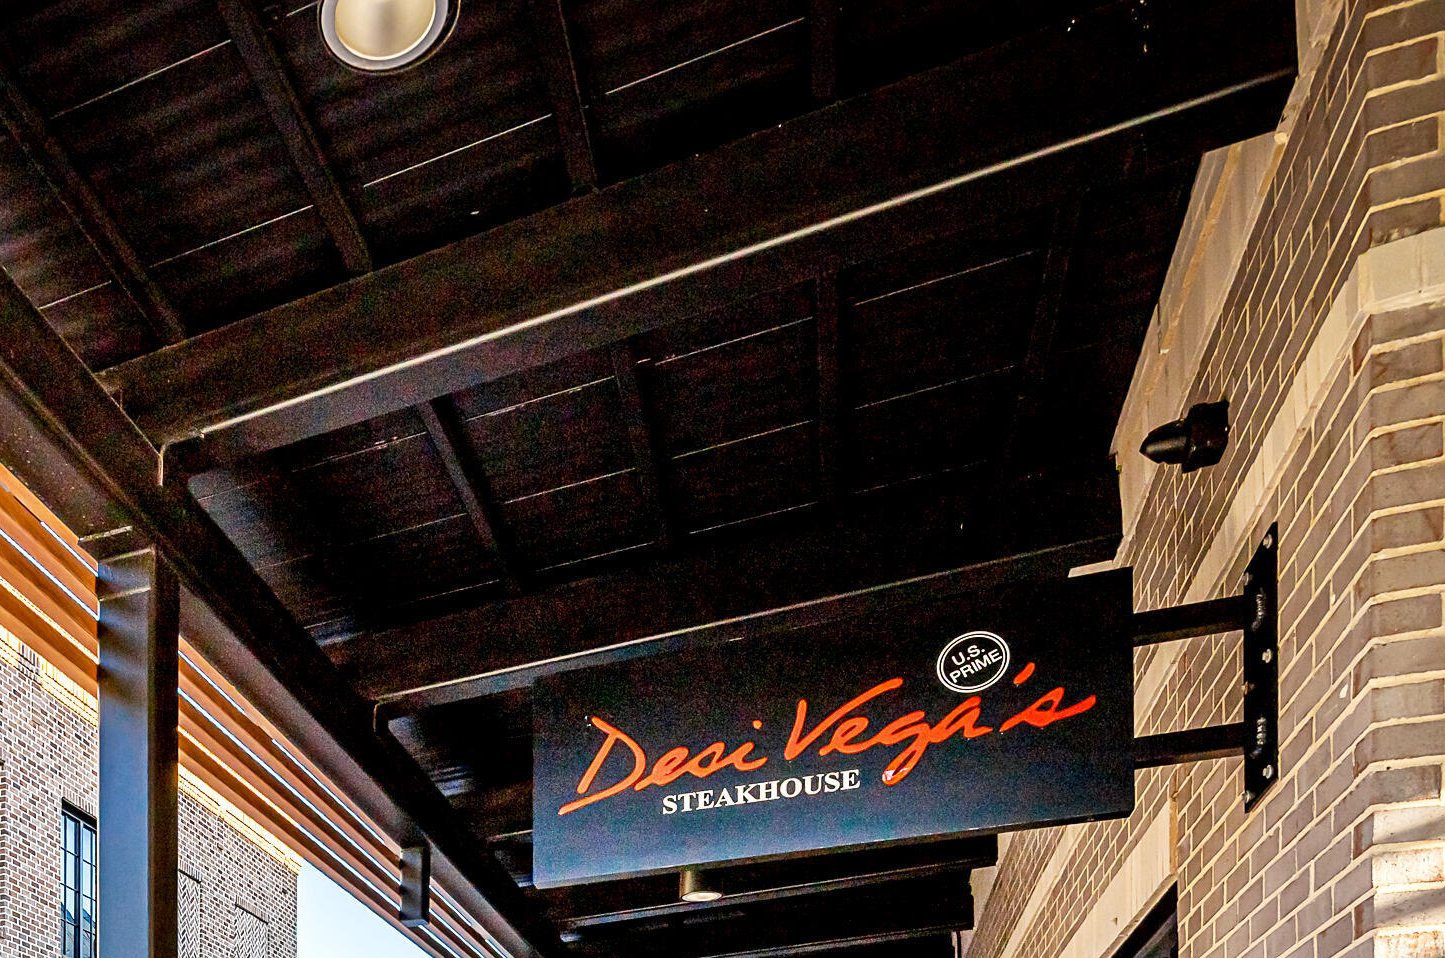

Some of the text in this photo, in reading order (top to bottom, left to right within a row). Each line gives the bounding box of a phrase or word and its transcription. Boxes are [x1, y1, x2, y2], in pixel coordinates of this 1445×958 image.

[949, 648, 1003, 684] PRIME
[951, 644, 986, 666] U.S.
[557, 662, 1097, 816] Desi Vega's
[661, 768, 861, 816] STEAKHOUSE
